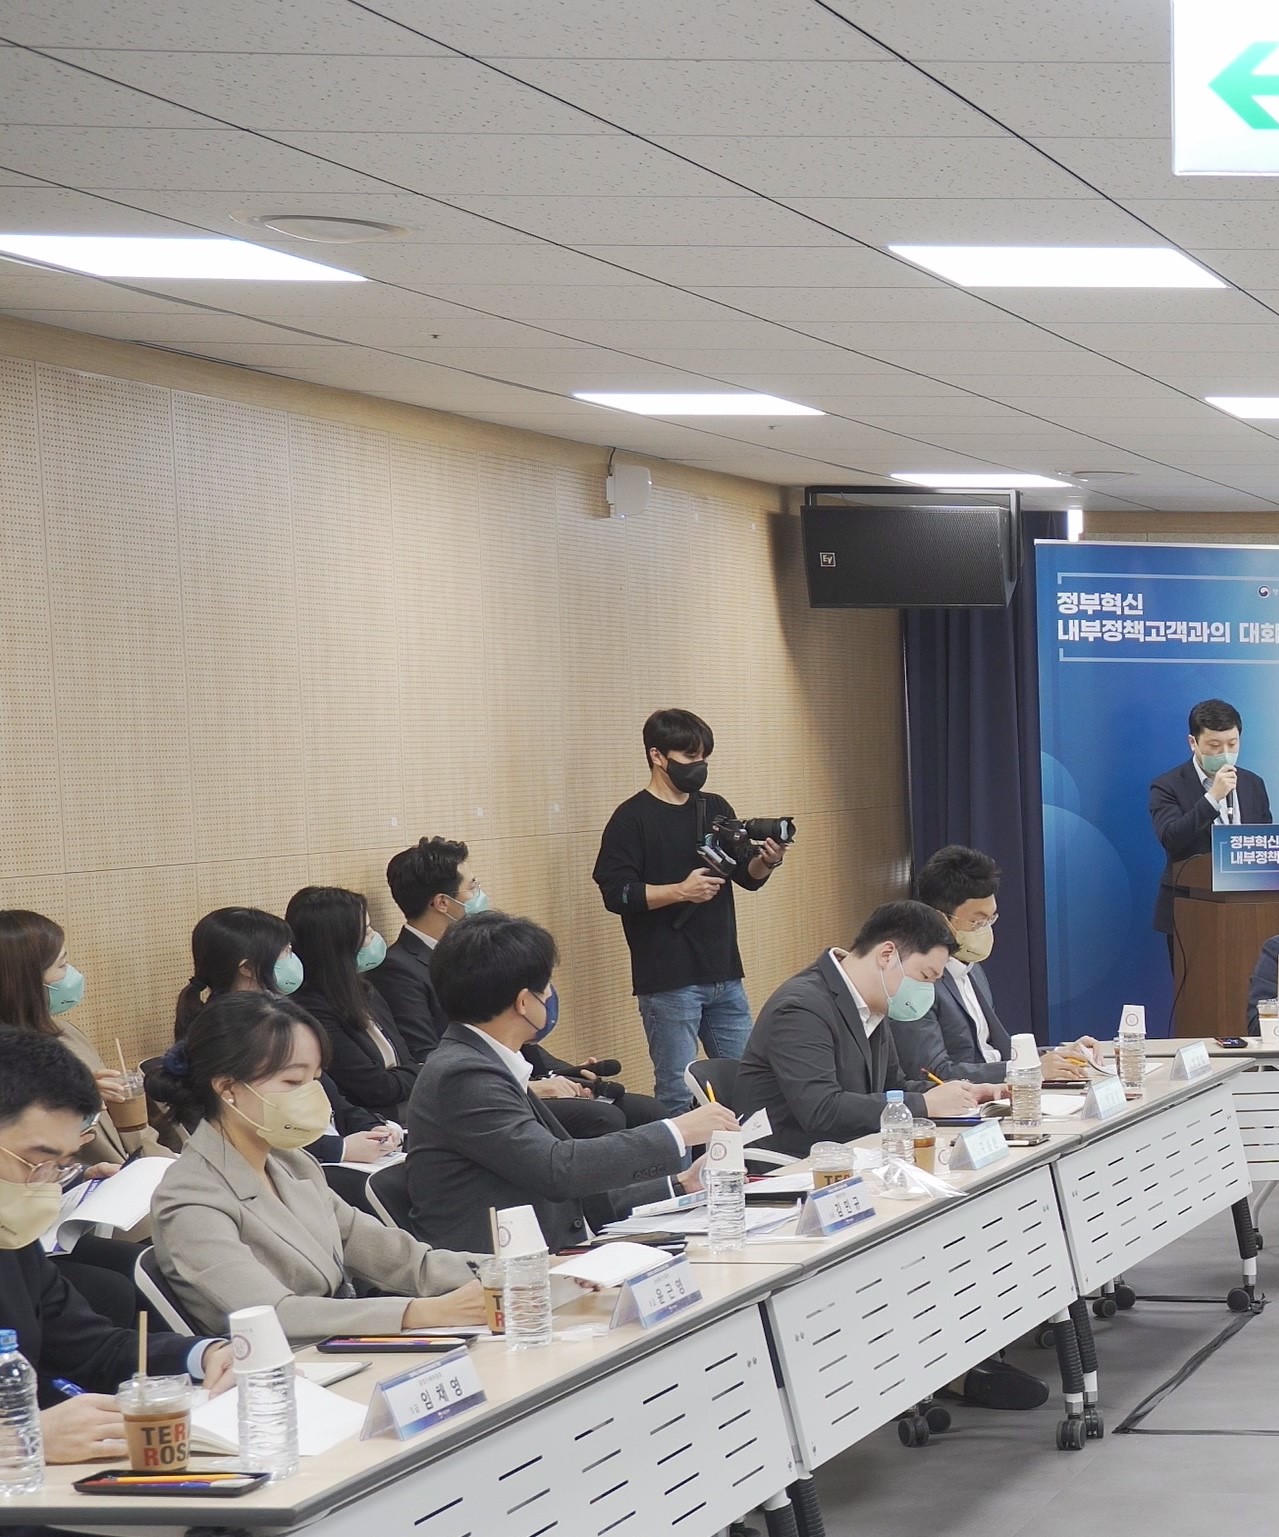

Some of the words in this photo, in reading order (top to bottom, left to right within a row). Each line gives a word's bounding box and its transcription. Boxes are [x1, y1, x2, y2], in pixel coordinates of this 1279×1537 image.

[1057, 592, 1143, 615] 정부혁신
[1057, 620, 1231, 643] 내부정책고객과의
[1230, 835, 1279, 849] 정부혁신
[141, 1423, 186, 1446] TER
[144, 1442, 188, 1466] ROS
